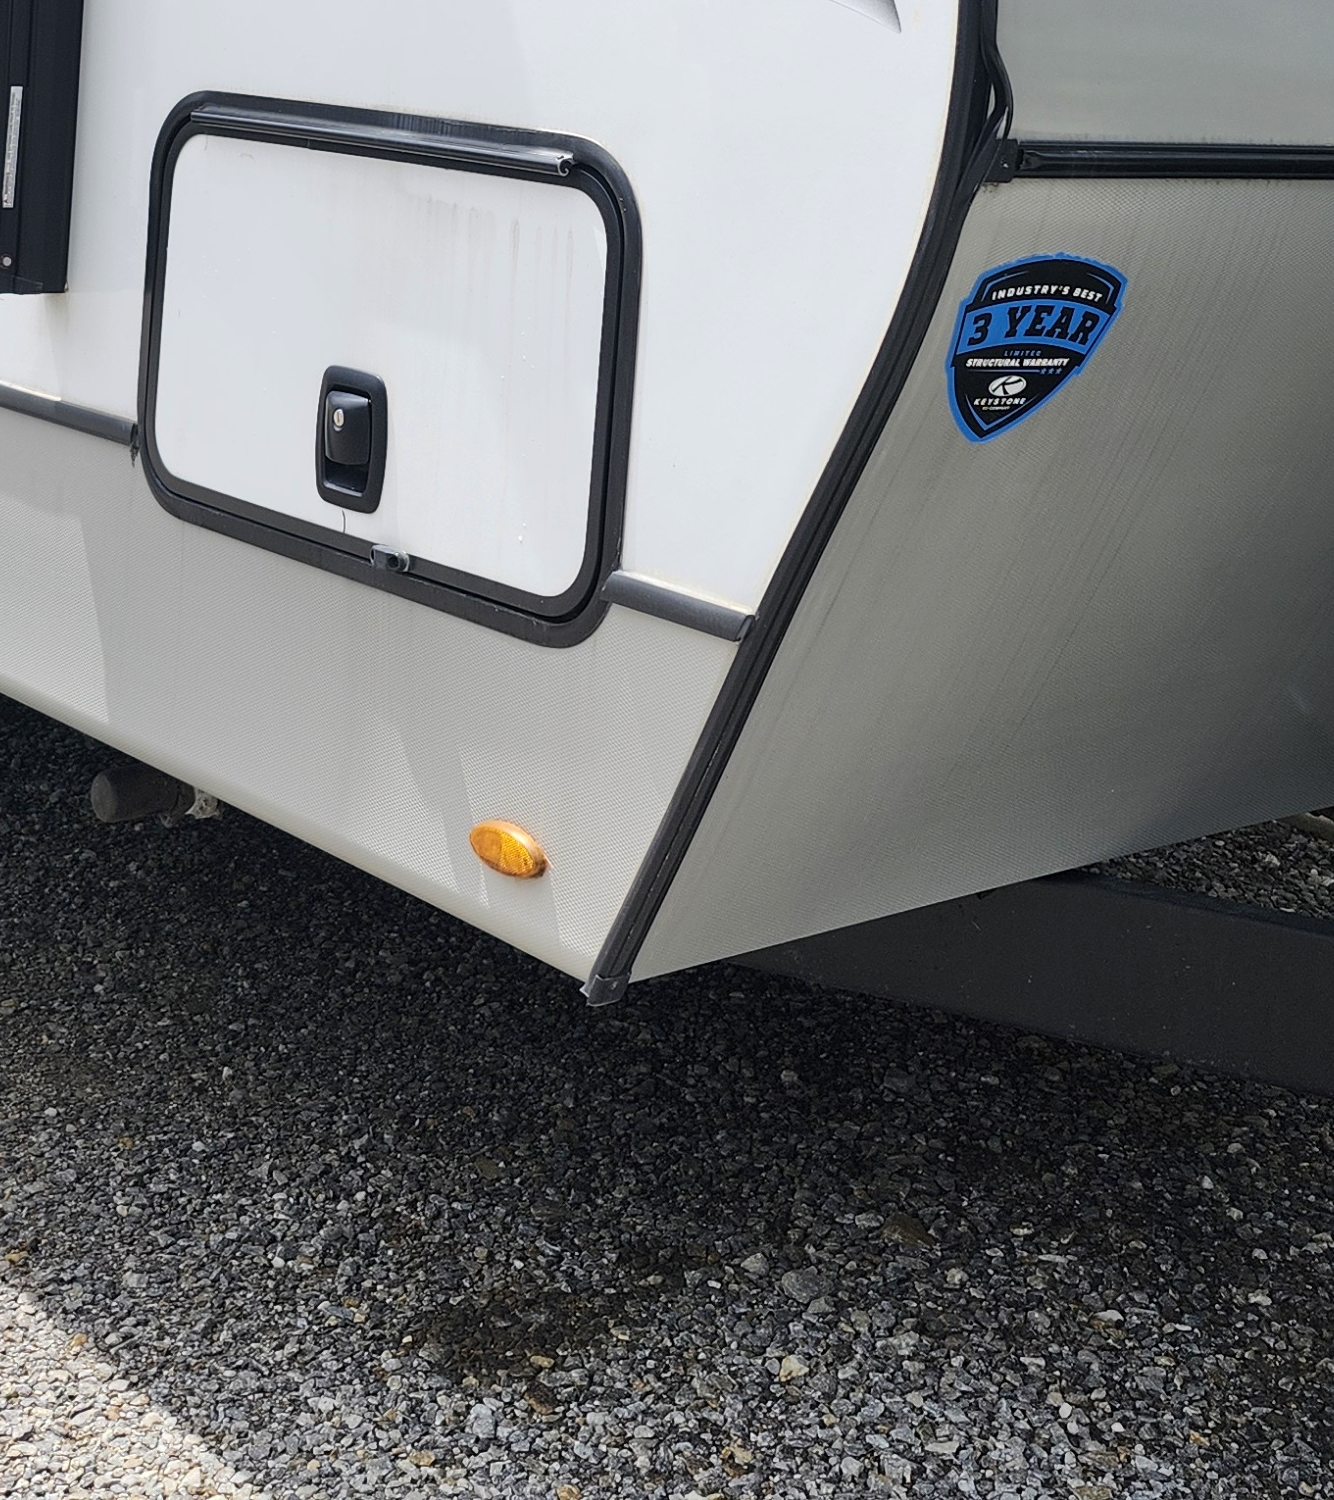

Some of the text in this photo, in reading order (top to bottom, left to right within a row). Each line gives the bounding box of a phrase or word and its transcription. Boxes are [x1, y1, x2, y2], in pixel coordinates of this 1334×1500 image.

[992, 284, 1103, 303] INDUSTRY'S BEST
[967, 305, 1100, 347] 3 YEAR
[966, 357, 1070, 368] STRUCTURAL WARRANTY
[973, 397, 1027, 406] KEYSTONE
